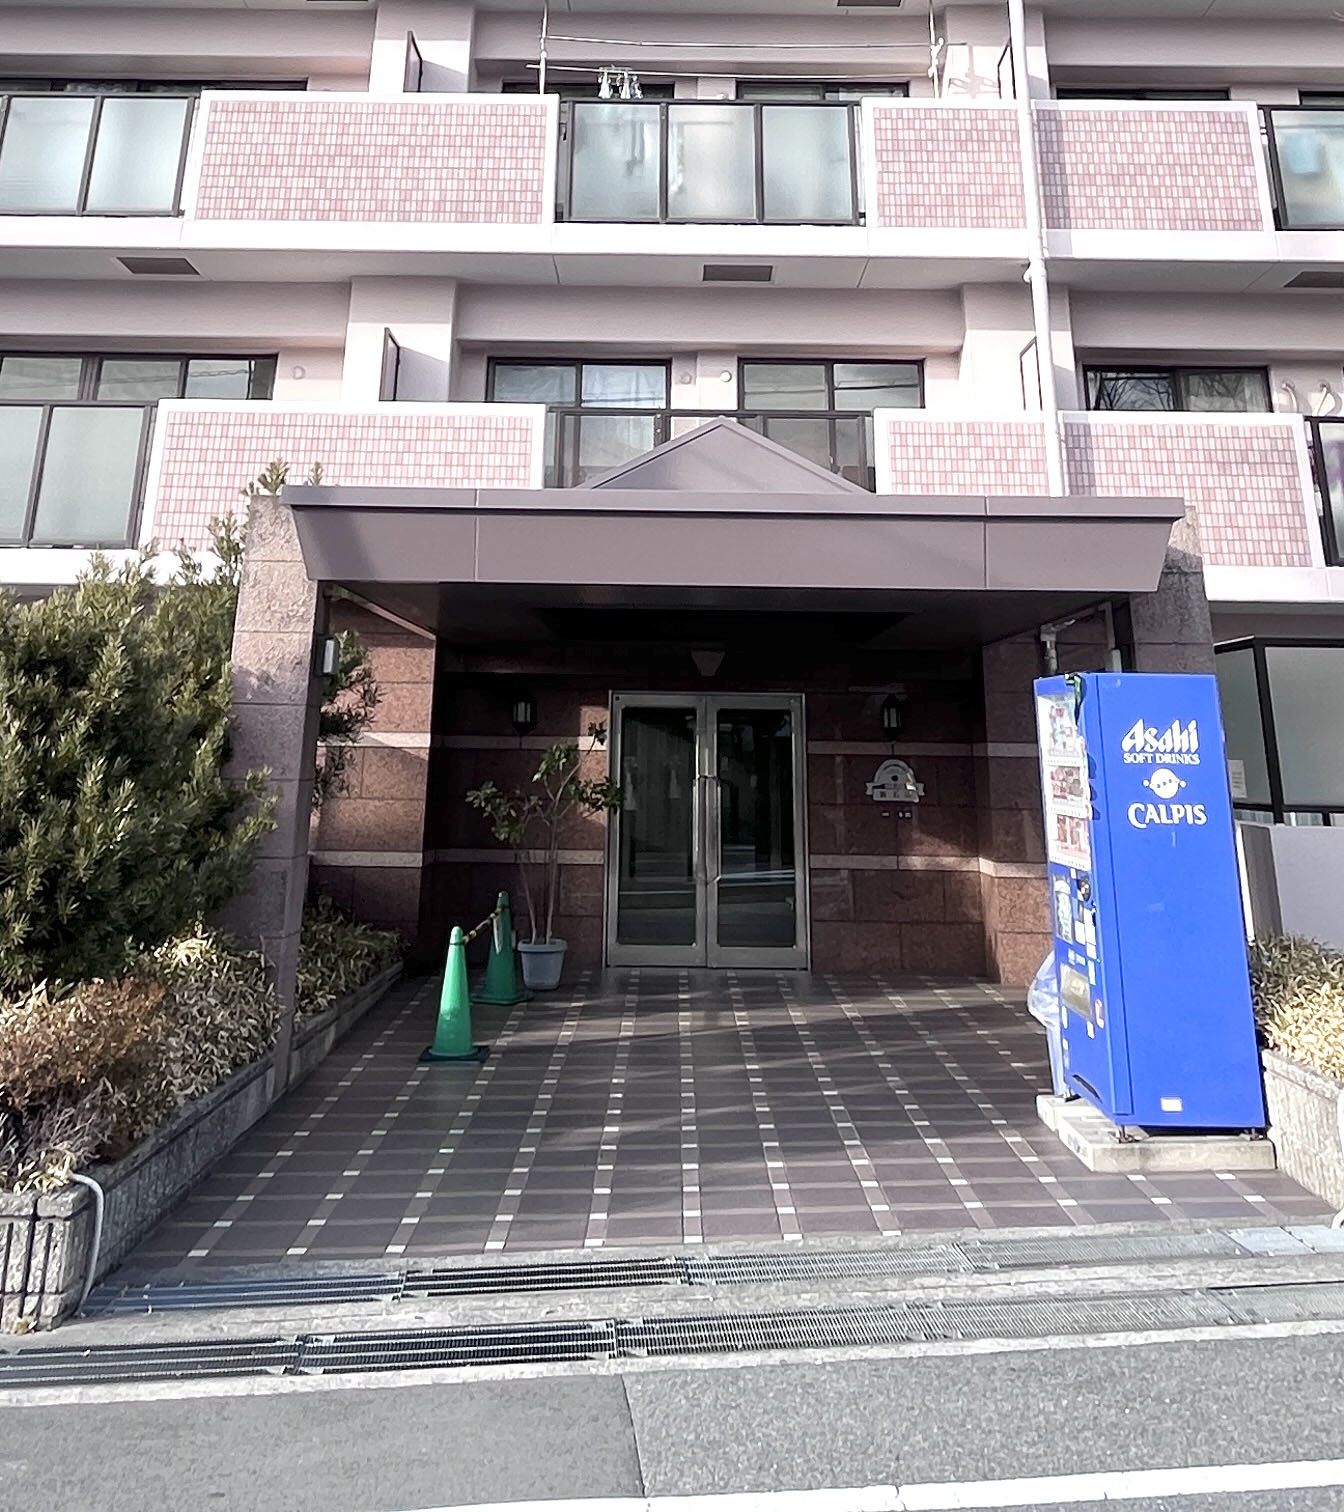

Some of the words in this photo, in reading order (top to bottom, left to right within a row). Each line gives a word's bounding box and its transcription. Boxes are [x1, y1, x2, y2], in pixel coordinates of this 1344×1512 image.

[1121, 717, 1199, 753] Asahi
[1123, 753, 1154, 765] SOFT
[1155, 753, 1201, 765] DRINKS
[1127, 802, 1208, 829] CALPIS
